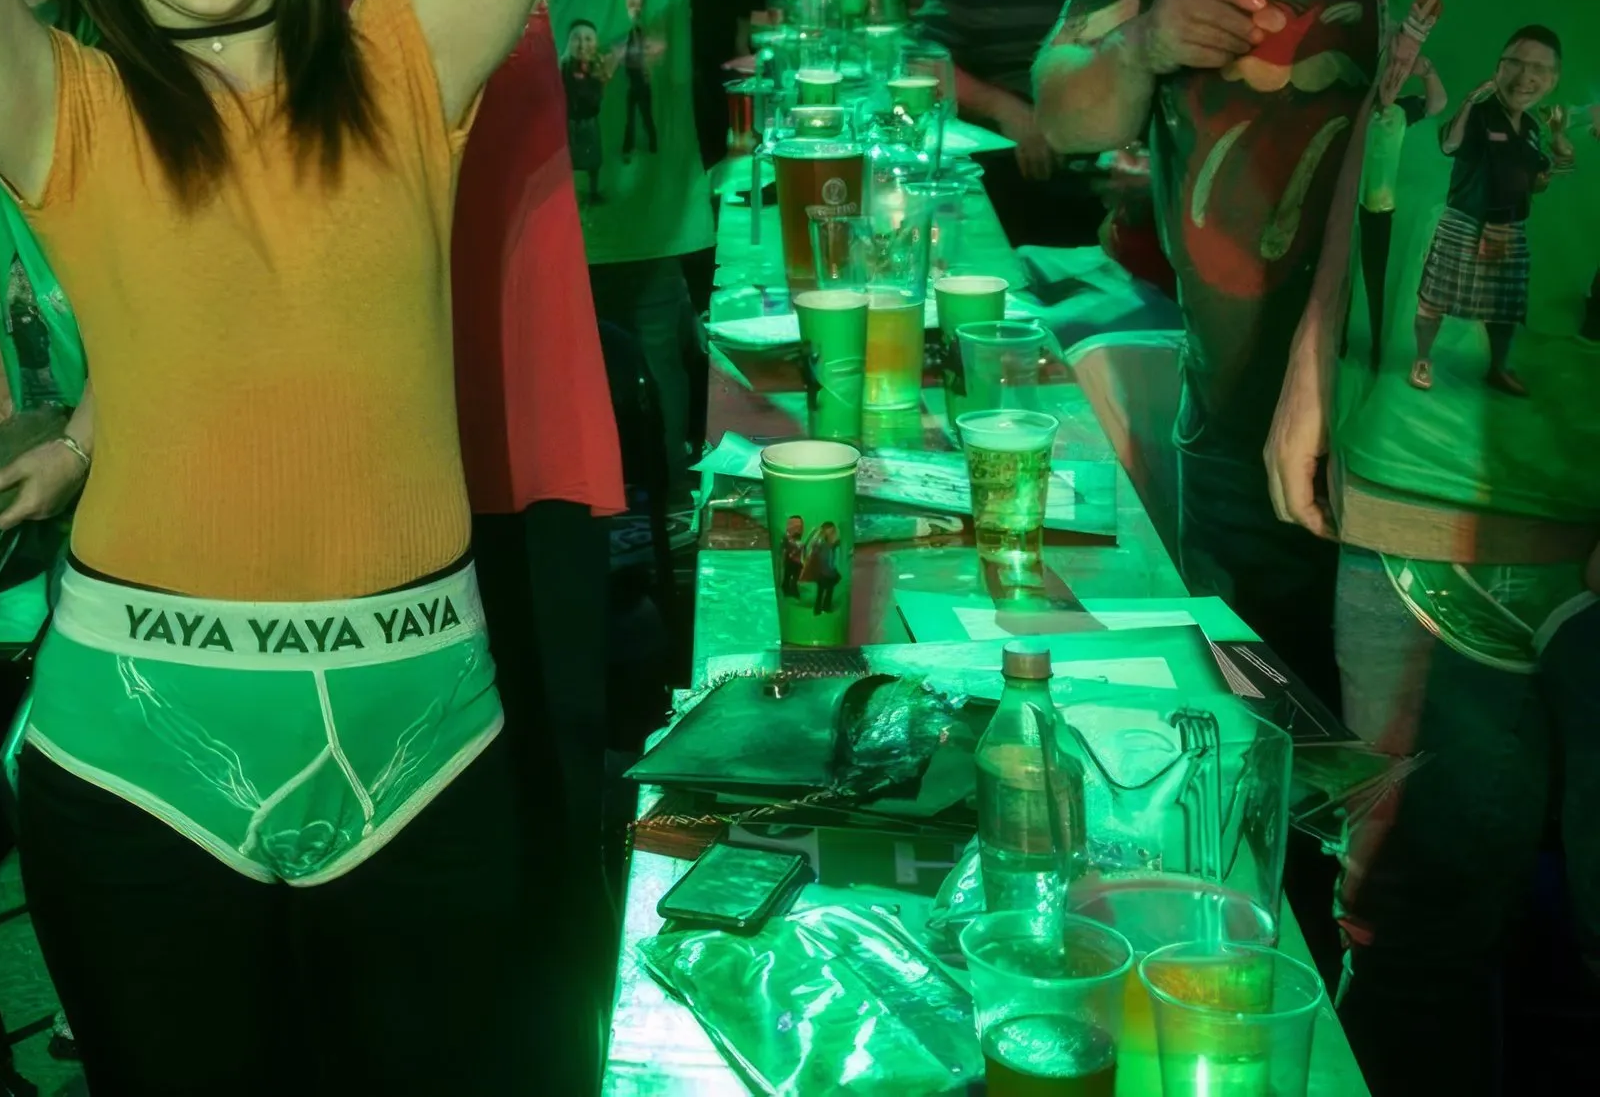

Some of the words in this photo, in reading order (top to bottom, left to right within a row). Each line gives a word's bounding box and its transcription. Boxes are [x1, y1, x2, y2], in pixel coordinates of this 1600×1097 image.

[124, 603, 234, 653] YAYA
[247, 615, 365, 654] YAYA
[373, 594, 462, 645] YAYA
